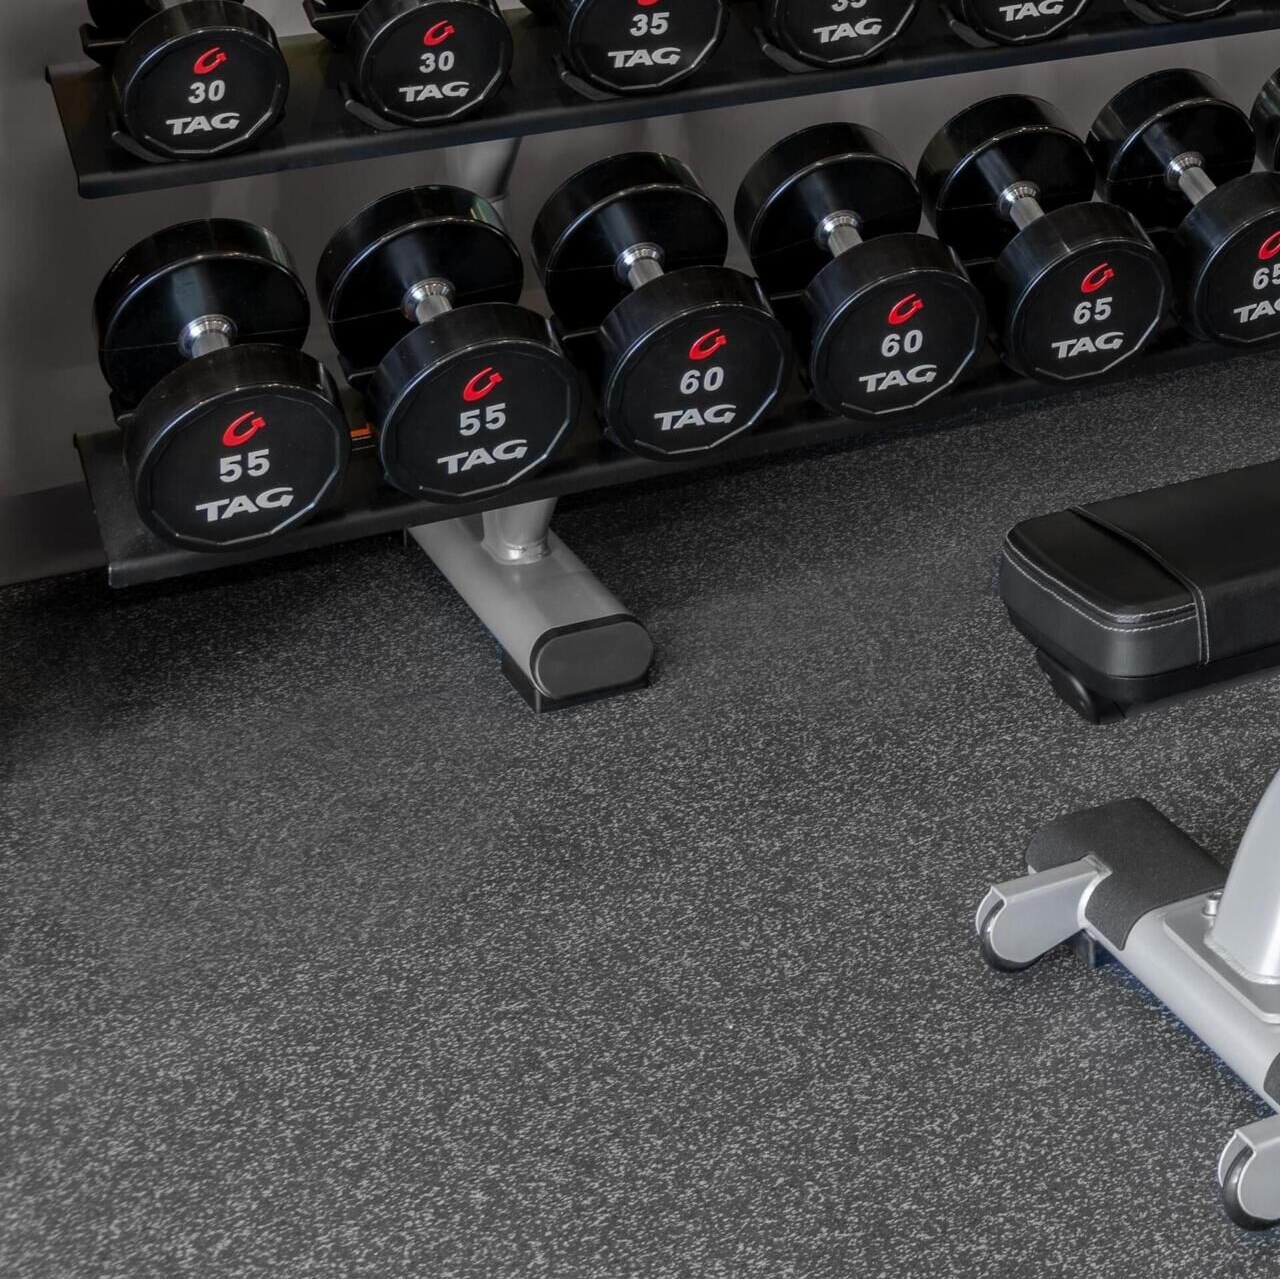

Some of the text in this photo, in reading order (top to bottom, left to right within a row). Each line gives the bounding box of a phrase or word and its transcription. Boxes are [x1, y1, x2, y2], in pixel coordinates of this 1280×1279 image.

[629, 11, 670, 37] 35
[812, 17, 882, 44] TAG
[419, 50, 455, 74] 30
[607, 46, 681, 69] TAG
[187, 79, 226, 104] 30
[398, 80, 470, 103] TAG
[165, 111, 240, 136] TAG
[1073, 296, 1113, 325] 65
[881, 329, 924, 358] 60
[1051, 331, 1124, 359] TAG
[679, 366, 725, 395] 60
[858, 363, 937, 393] TAG
[459, 402, 507, 437] 55
[653, 403, 737, 431] TAG
[219, 448, 271, 483] 55
[436, 439, 528, 475] TAG
[194, 486, 295, 523] TAG
